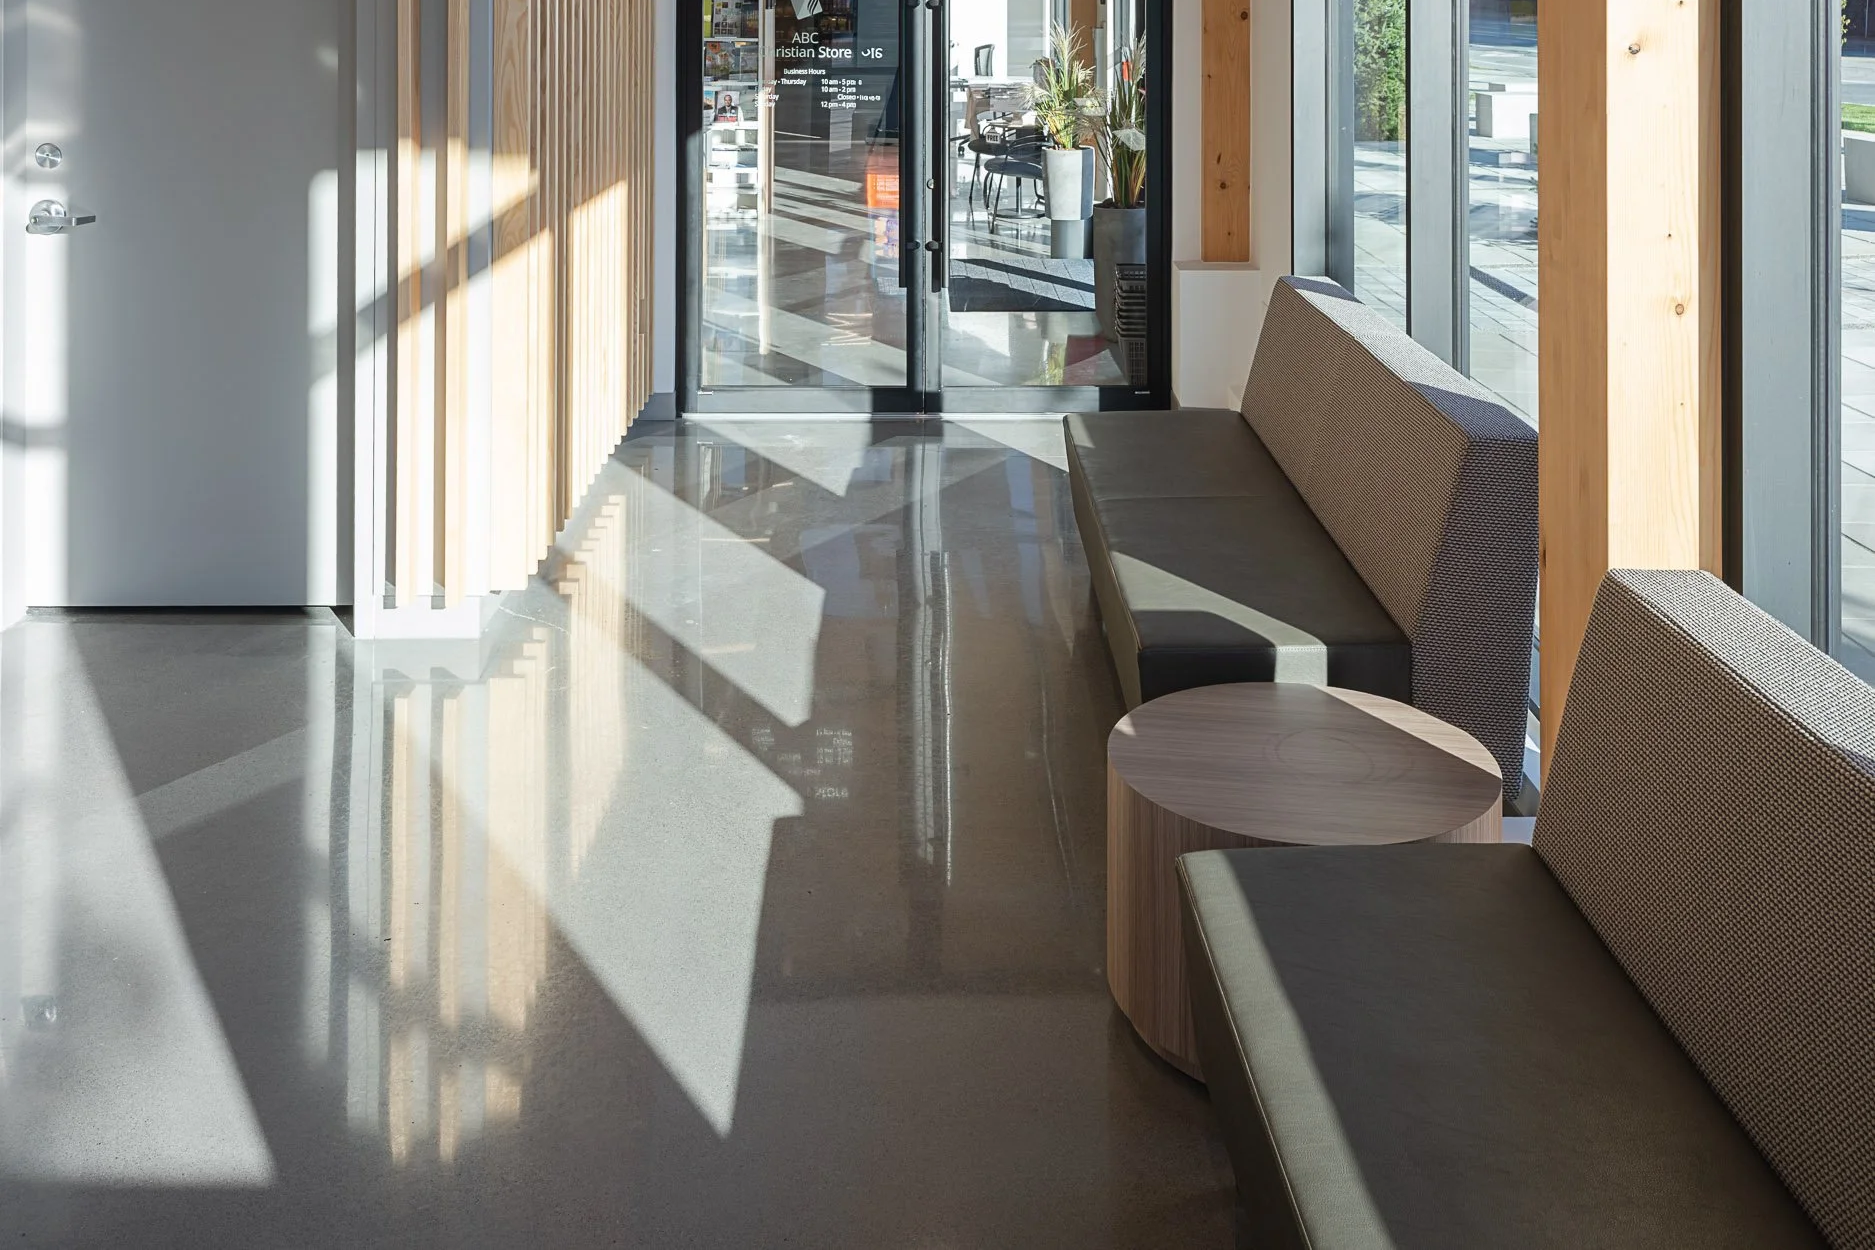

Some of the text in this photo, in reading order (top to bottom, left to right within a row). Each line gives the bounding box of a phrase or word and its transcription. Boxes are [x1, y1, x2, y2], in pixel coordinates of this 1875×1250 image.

[792, 32, 819, 44] ABC
[818, 46, 852, 58] Store
[781, 78, 807, 86] Thursday
